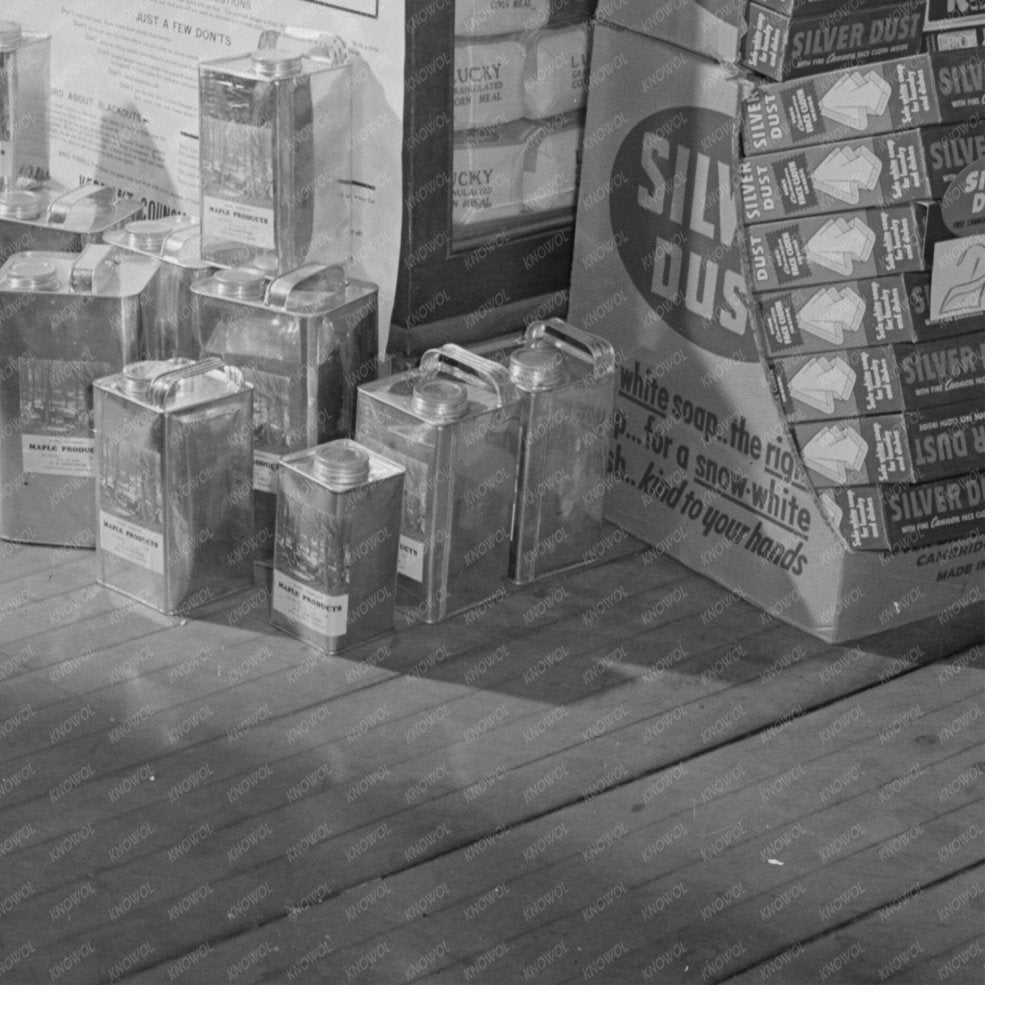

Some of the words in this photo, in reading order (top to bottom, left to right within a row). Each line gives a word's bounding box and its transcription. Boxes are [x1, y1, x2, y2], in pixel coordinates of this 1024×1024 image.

[491, 0, 510, 10] CORN
[135, 11, 159, 28] JUST
[162, 18, 170, 30] A
[172, 21, 192, 36] FEW
[195, 26, 232, 47] DON'TS
[67, 91, 94, 105] ABOUT
[97, 101, 142, 123] BLACKOUTS
[740, 162, 761, 221] SILVER
[756, 164, 775, 211] DUST
[619, 360, 669, 411] white
[29, 442, 58, 452] MAPLE
[677, 444, 690, 470] a
[694, 453, 812, 533] snow-white
[679, 490, 703, 521] to
[702, 505, 751, 538] your
[743, 520, 809, 577] hands
[936, 562, 973, 583] MADE
[277, 580, 300, 598] MAPLE
[302, 592, 343, 613] PRODUCTS
